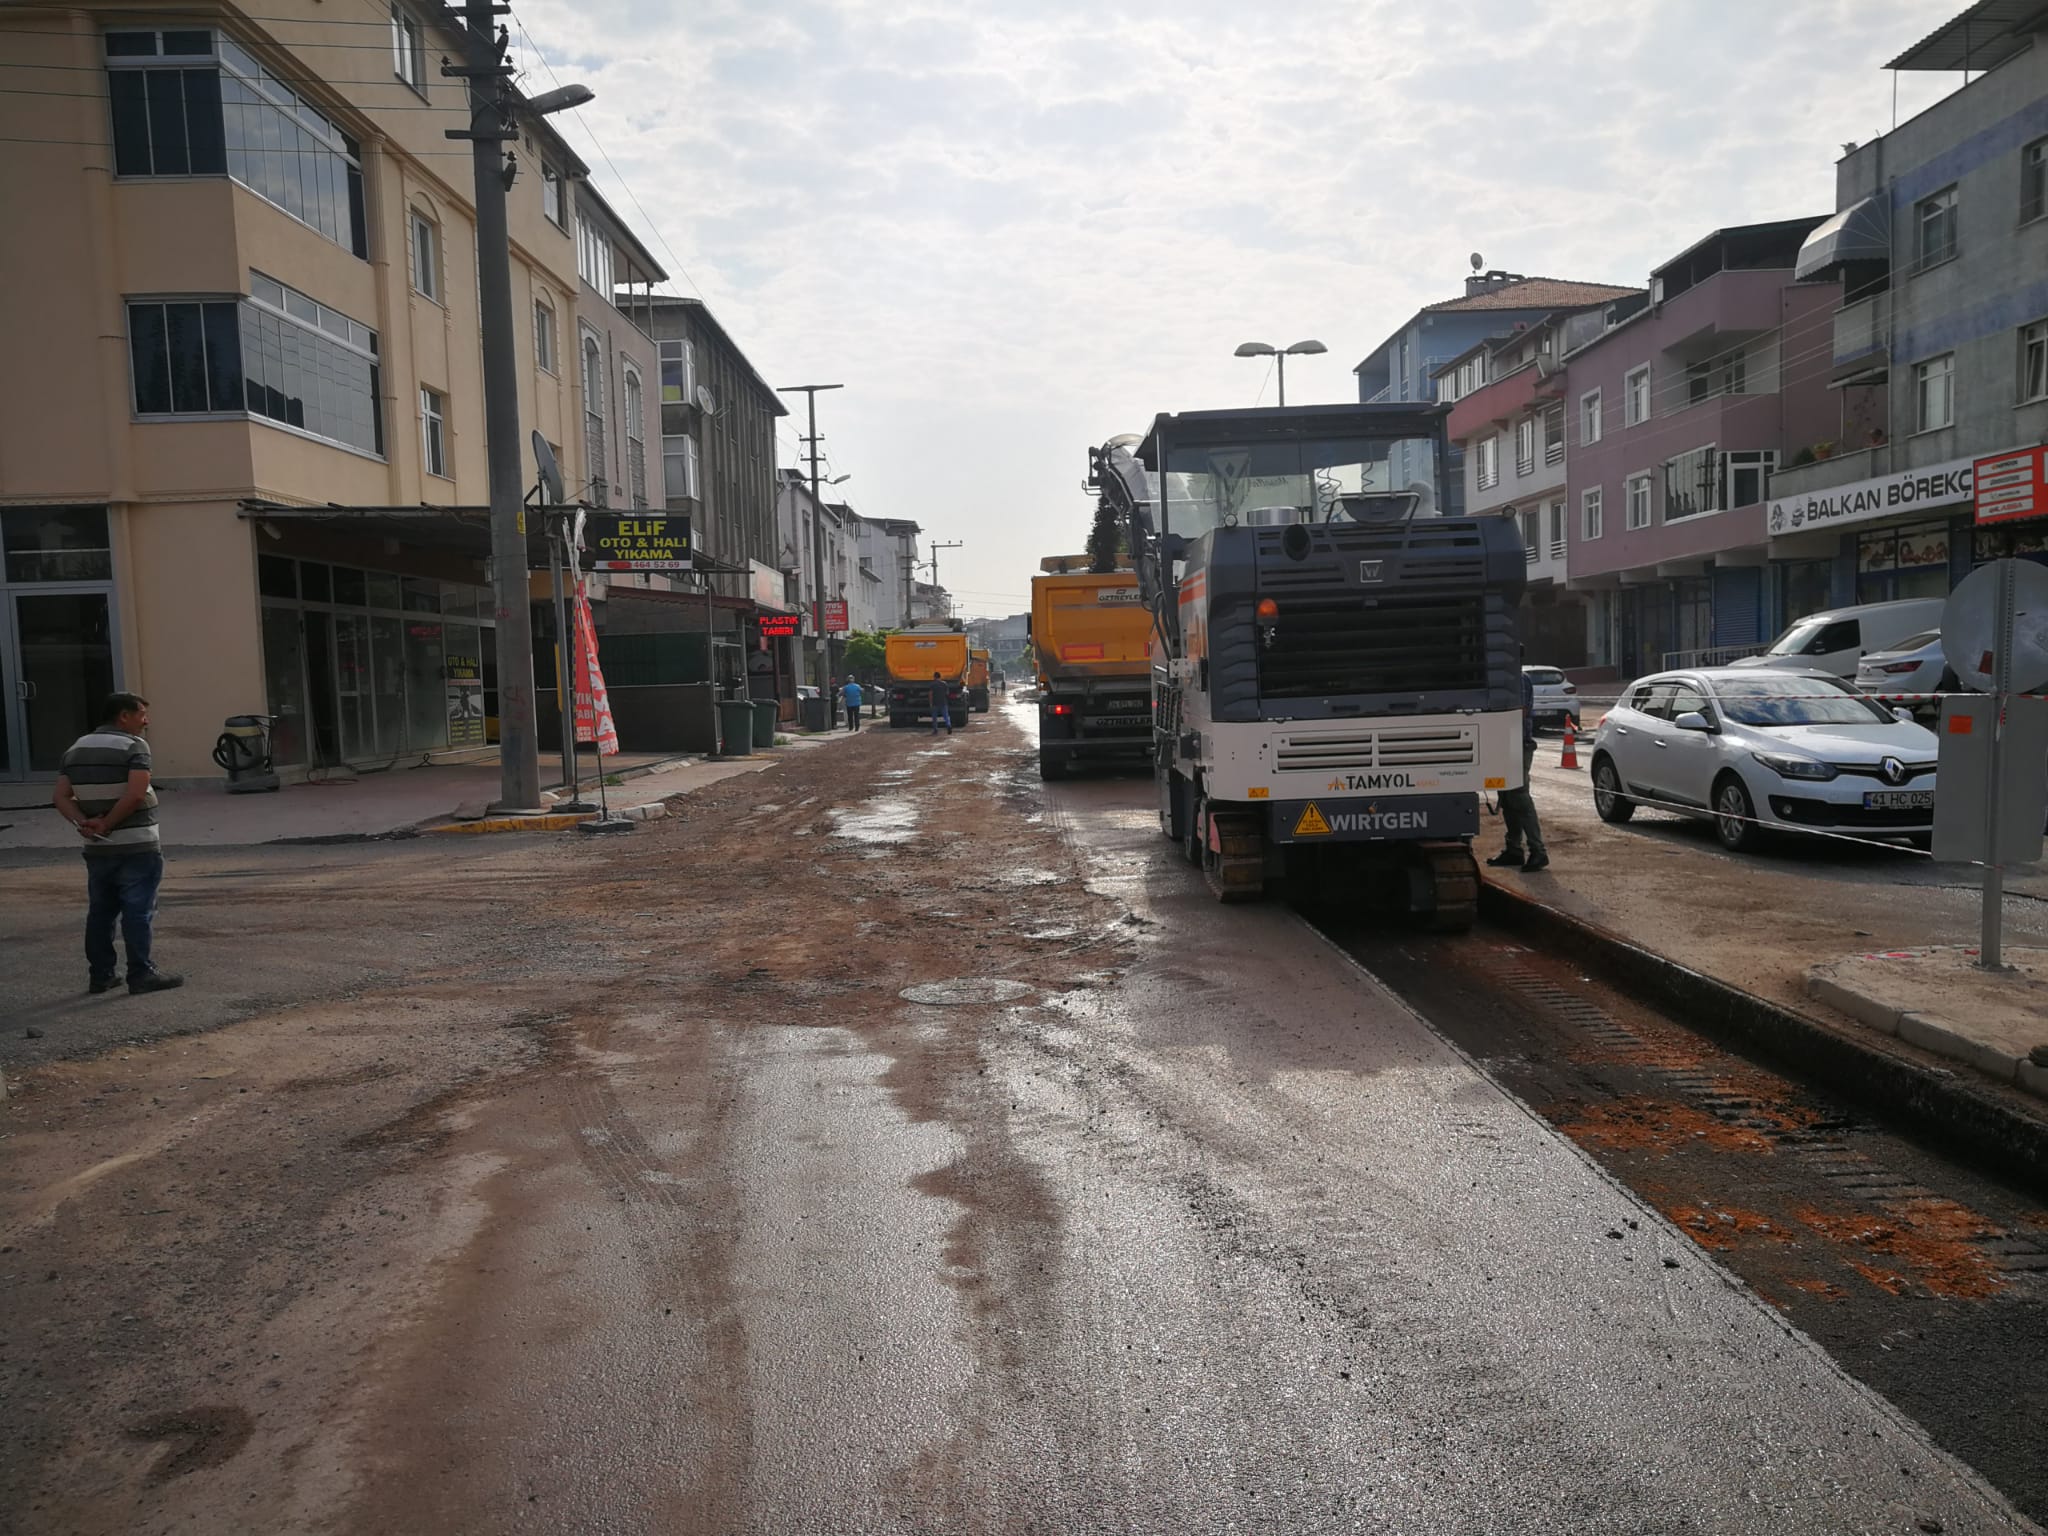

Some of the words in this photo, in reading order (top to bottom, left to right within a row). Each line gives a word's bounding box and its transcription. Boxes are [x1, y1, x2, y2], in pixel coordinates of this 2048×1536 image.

[1807, 488, 1881, 521] BALKAN
[599, 537, 631, 548] OTO
[636, 537, 648, 548] &
[653, 537, 687, 548] HALI
[614, 549, 673, 559] YIKAMA
[654, 561, 666, 569] 52
[667, 561, 680, 569] 69
[1346, 773, 1416, 790] TAMYOL
[1872, 793, 1886, 805] 41
[1890, 793, 1907, 805] HC
[1910, 792, 1931, 804] 025
[1329, 811, 1428, 832] WIRTGEN
